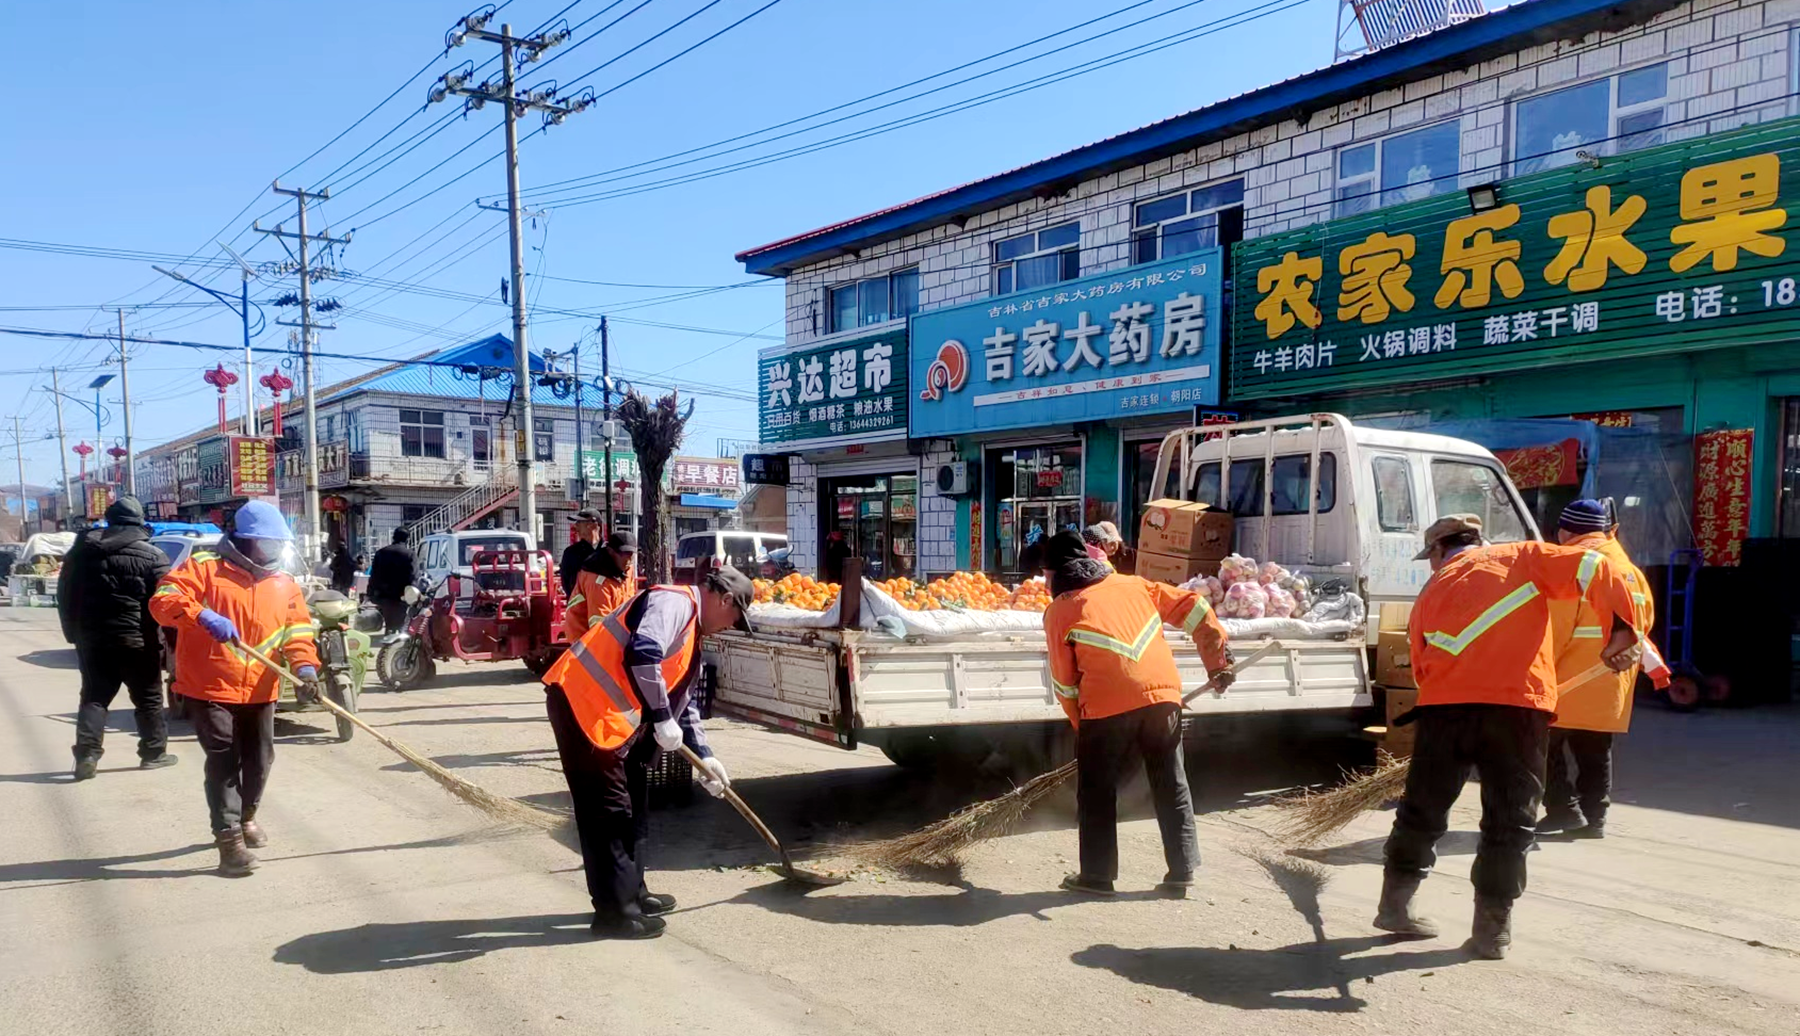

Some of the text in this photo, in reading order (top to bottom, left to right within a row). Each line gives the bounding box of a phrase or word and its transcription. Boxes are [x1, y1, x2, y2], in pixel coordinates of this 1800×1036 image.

[1254, 152, 1788, 340] 农家乐水果
[987, 263, 1207, 319] 吉林省吉家大药房有限公司
[982, 291, 1206, 382] 吉家大药房
[1253, 340, 1338, 375] 牛羊肉片
[1359, 322, 1457, 362] 火锅调料
[1482, 301, 1599, 348] 蔬菜干调
[1761, 277, 1800, 308] 18
[767, 342, 893, 409] 兴达超市
[1120, 388, 1202, 409] 吉家连锁 朝阳店
[808, 403, 845, 422] 烟酒糖茶
[853, 396, 894, 417] 粮油水果
[686, 463, 738, 485] 早餐店
